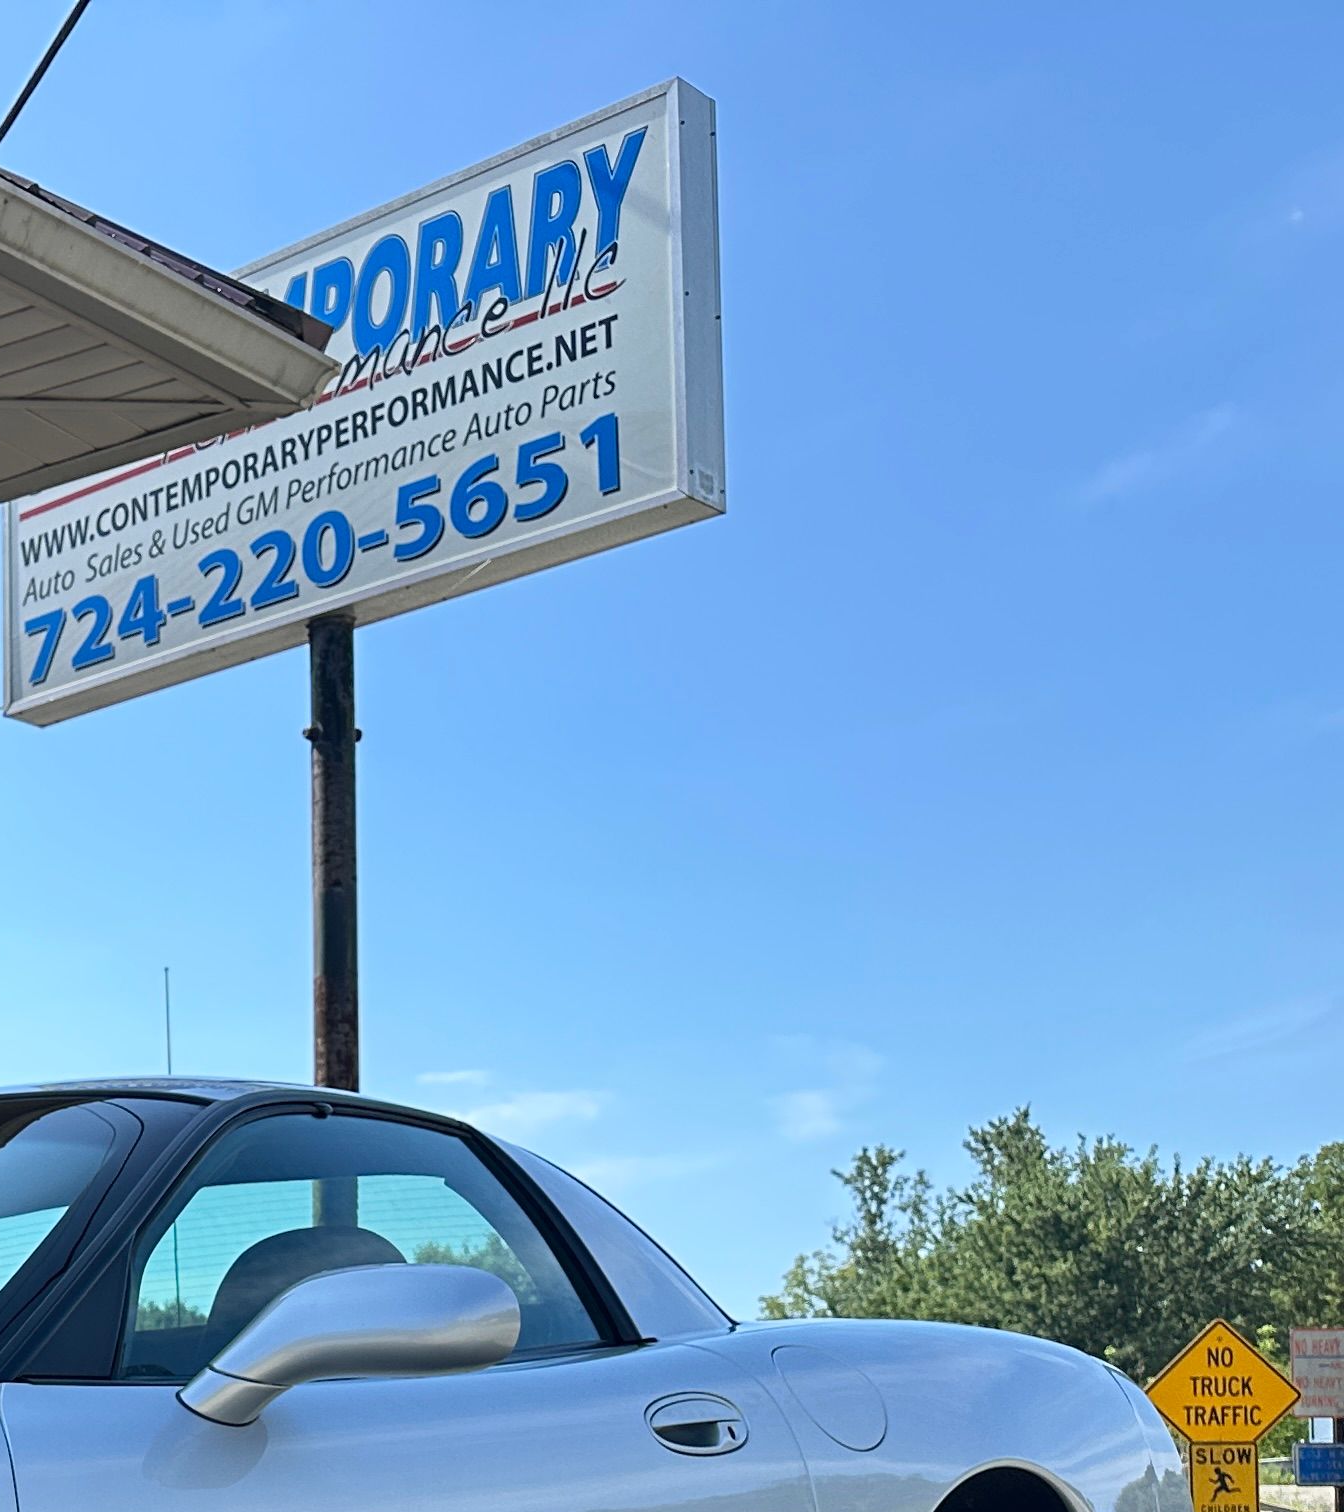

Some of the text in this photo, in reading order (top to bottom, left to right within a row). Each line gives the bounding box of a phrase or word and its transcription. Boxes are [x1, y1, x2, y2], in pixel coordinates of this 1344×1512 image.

[284, 125, 649, 358] PORARY
[20, 315, 620, 567] WWW.CONTEMPORARYPERFORMANCE.NET
[22, 569, 75, 606] Auto
[85, 543, 142, 583] Sales
[148, 529, 166, 559] &
[173, 502, 231, 549] Used
[236, 485, 280, 525] GM
[286, 427, 456, 509] Performance
[462, 401, 532, 447] Auto
[540, 369, 617, 418] Parts
[24, 412, 622, 687] 724-220-5651
[1183, 1405, 1262, 1426] TRAFFIC
[1190, 1376, 1253, 1397] TRUCK
[1206, 1346, 1234, 1368] NO
[1195, 1447, 1251, 1465] SLOW
